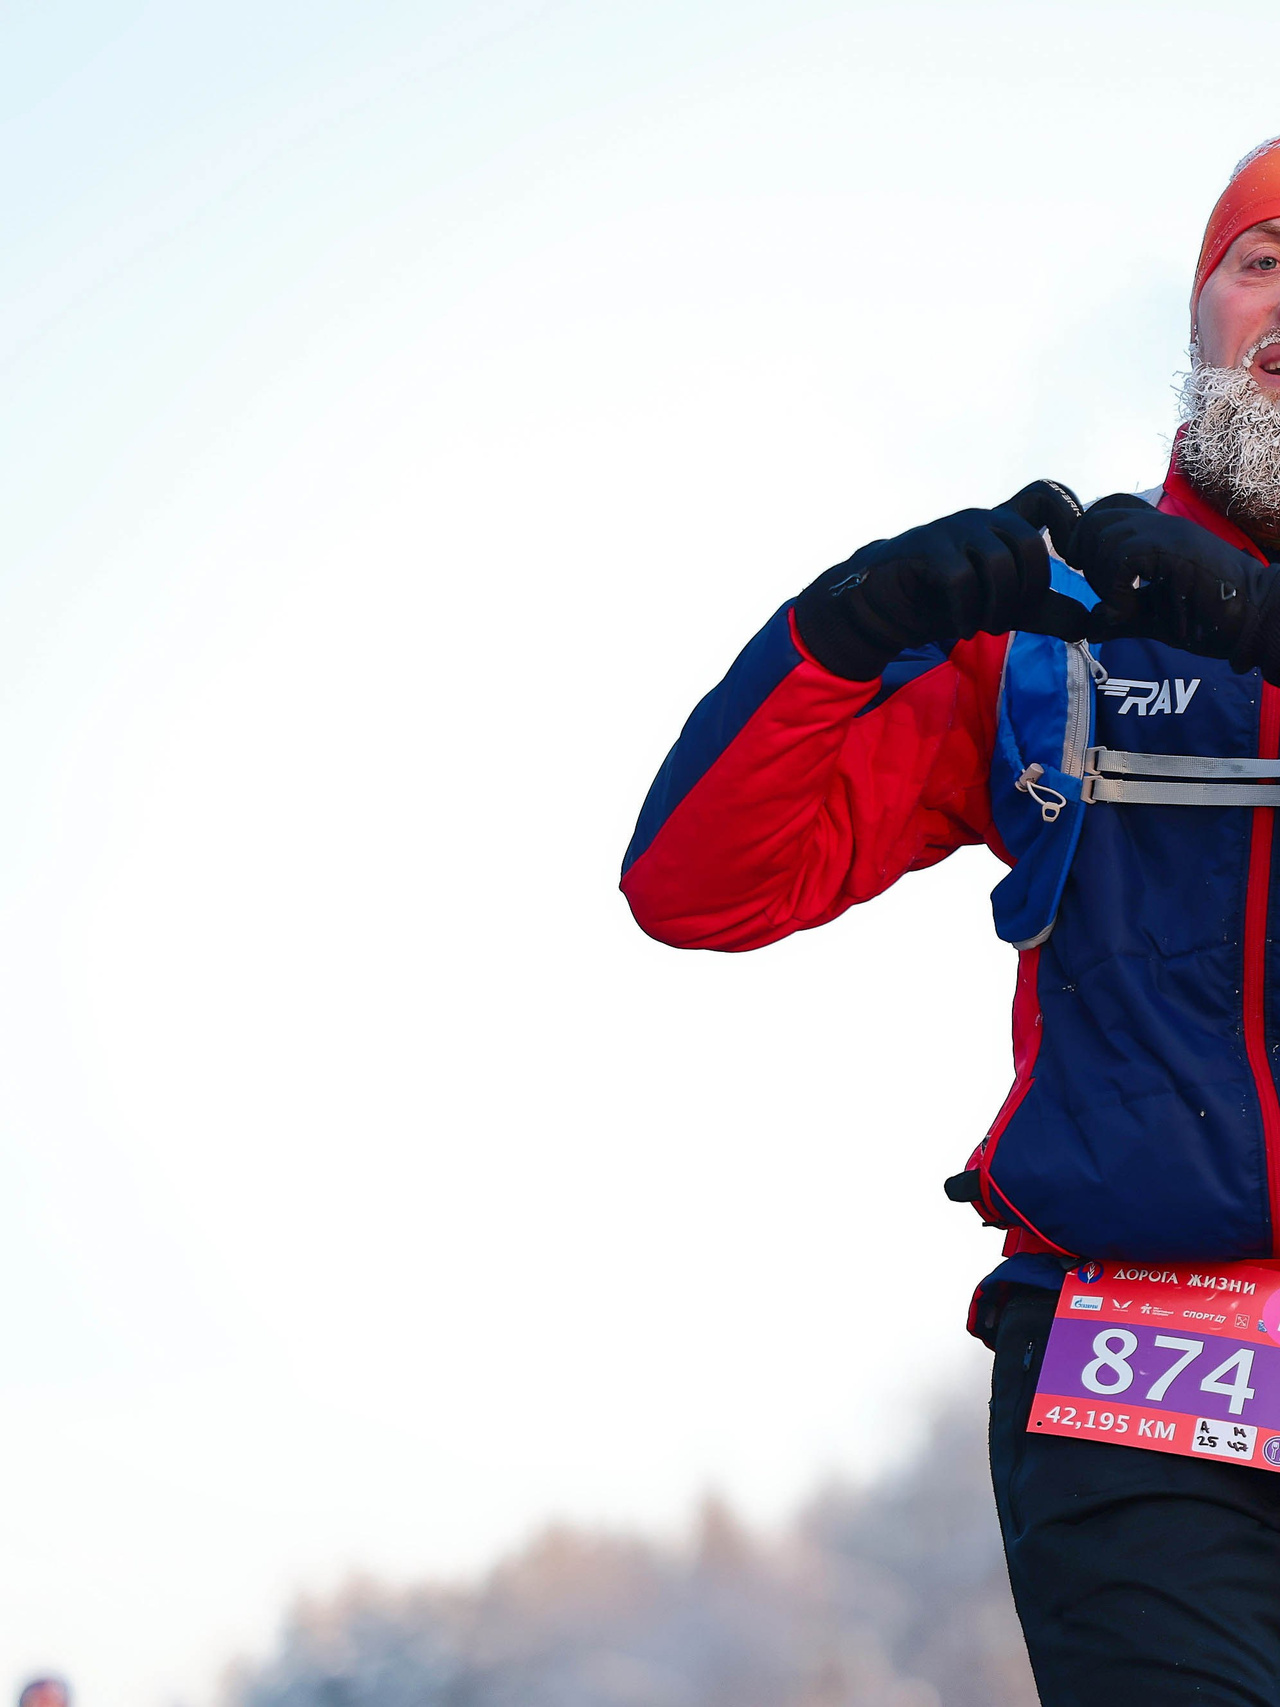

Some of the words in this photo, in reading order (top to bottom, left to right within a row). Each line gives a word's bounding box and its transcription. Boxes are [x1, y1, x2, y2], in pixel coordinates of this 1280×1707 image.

[1097, 678, 1201, 716] RAY
[1113, 1269, 1179, 1284] ДОРОГА
[1187, 1273, 1256, 1295] ЖИЗНИ
[1081, 1328, 1256, 1415] 874
[1046, 1406, 1130, 1433] 42,195
[1138, 1418, 1176, 1441] КМ
[1196, 1435, 1219, 1448] 25
[1226, 1440, 1249, 1452] 47
